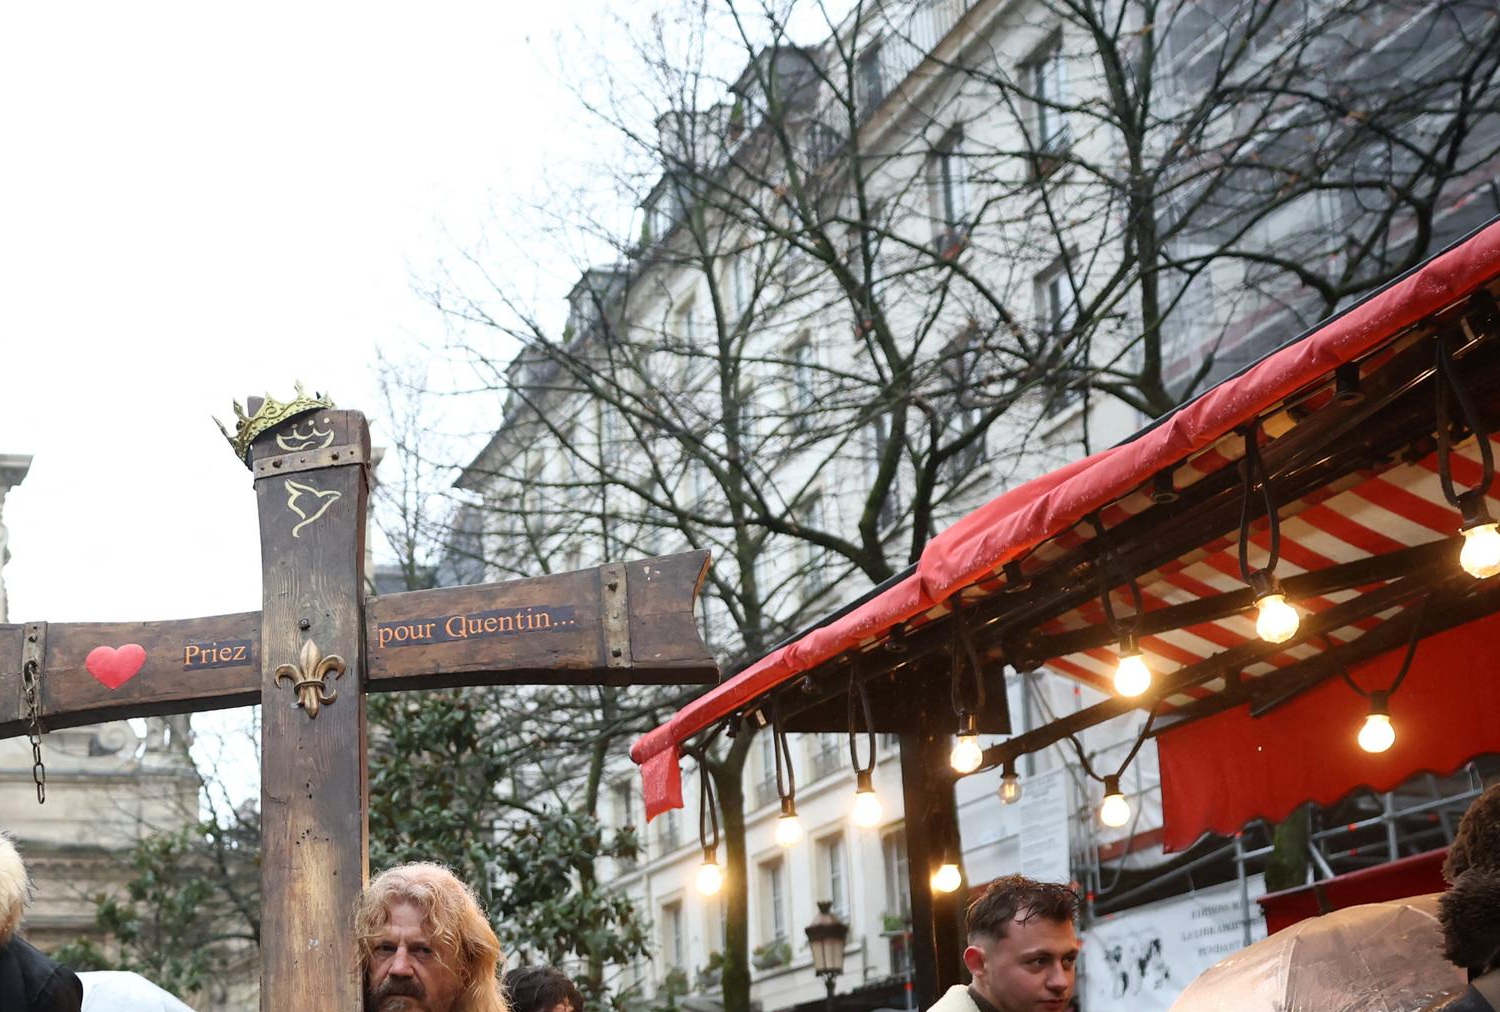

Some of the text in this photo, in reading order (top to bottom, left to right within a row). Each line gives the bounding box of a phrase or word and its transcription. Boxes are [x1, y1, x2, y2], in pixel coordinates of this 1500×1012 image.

[184, 607, 575, 665] Priez pour Quentin...
